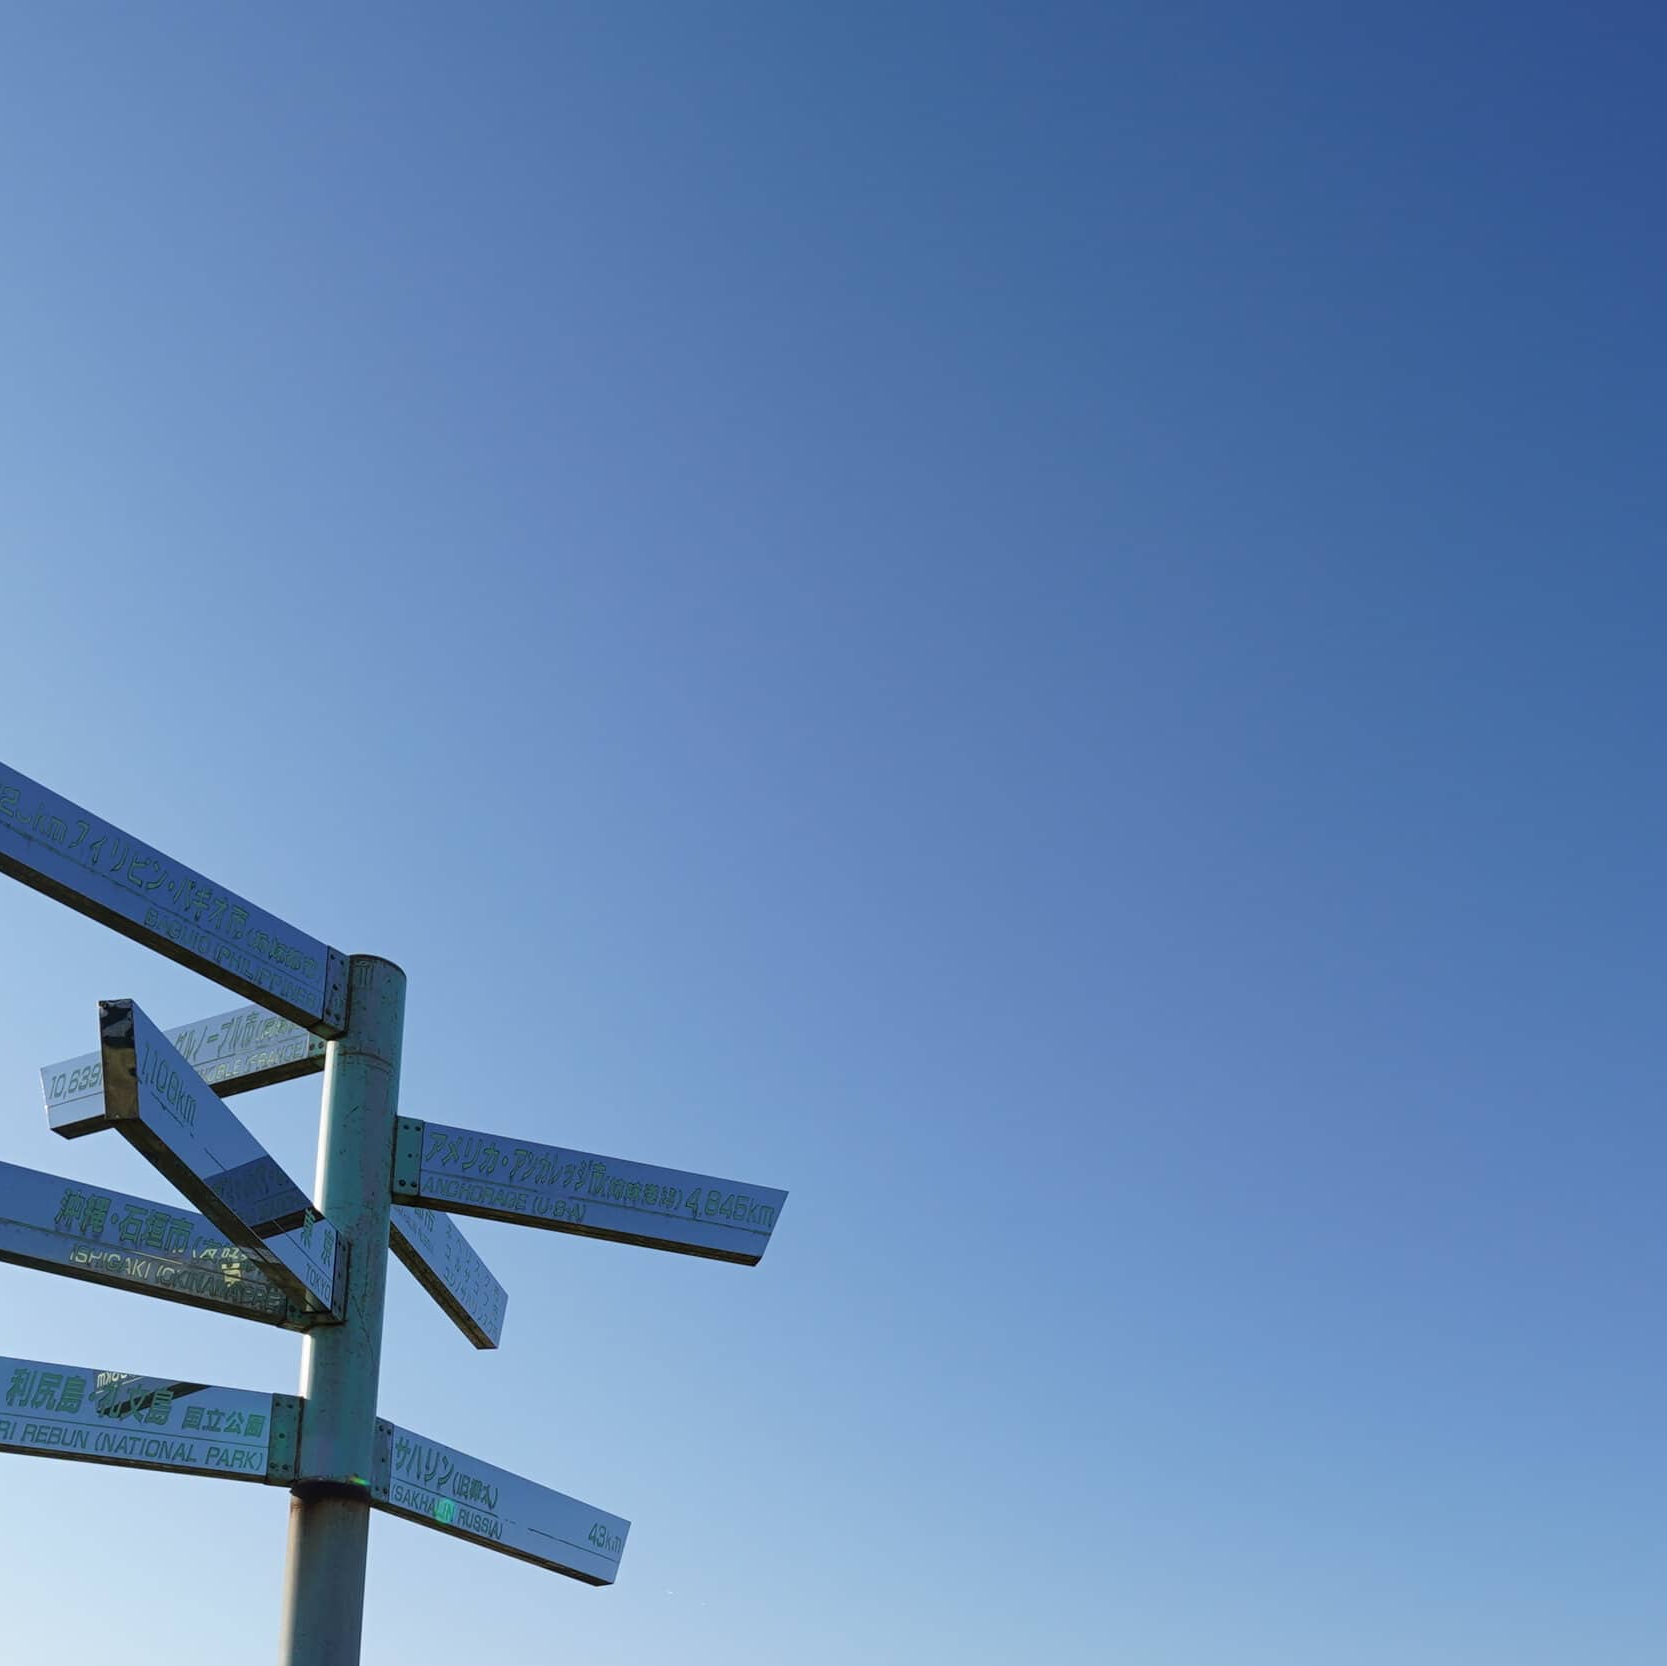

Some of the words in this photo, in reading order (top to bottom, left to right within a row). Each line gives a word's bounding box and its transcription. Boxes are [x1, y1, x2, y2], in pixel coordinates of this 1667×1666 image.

[69, 1244, 151, 1280] ISHIGAKI
[303, 1262, 332, 1300] TOKYO
[181, 1405, 268, 1438] 国立公園
[20, 1423, 89, 1449] REBUN
[94, 1431, 198, 1463] (NATIONAL
[204, 1446, 264, 1472] PARK)
[391, 1483, 455, 1523] (SAKHALIN
[458, 1508, 503, 1540] RUSSIA)
